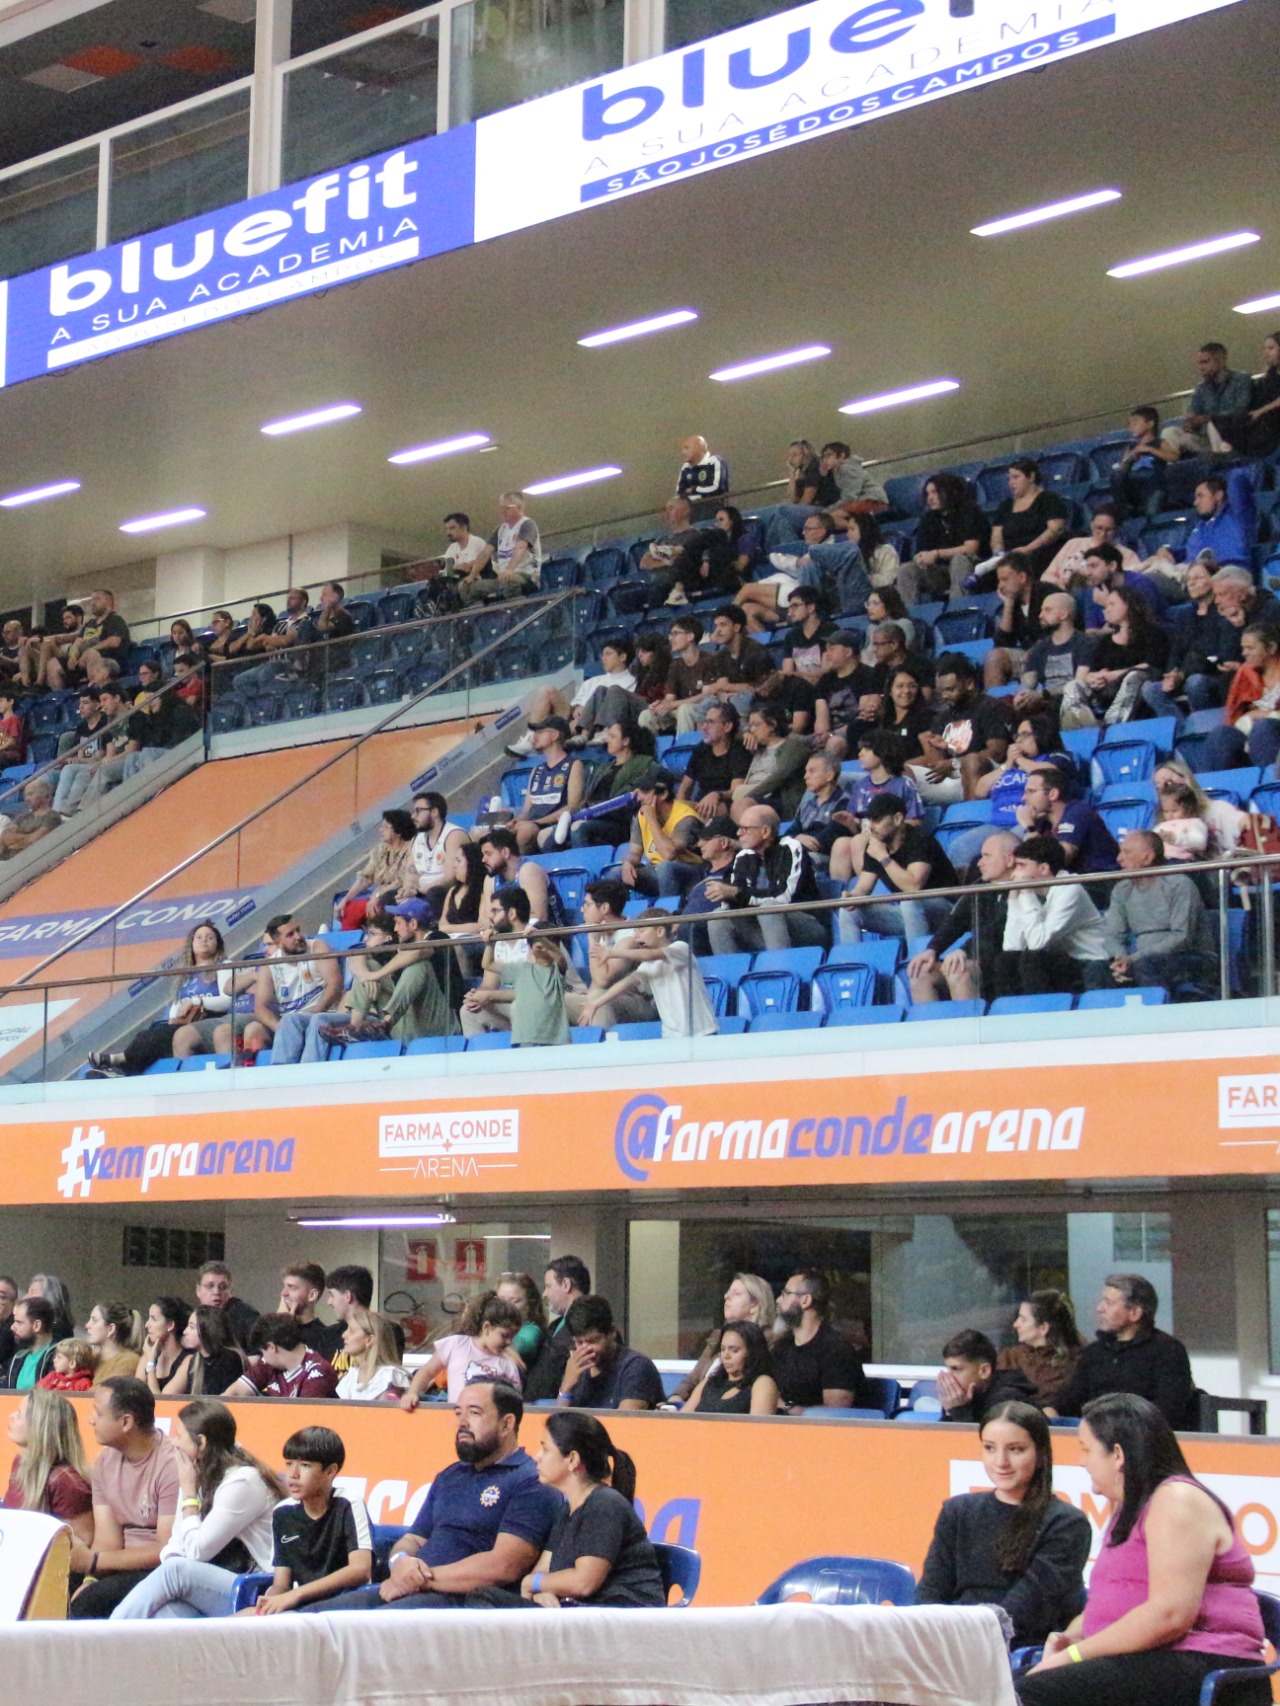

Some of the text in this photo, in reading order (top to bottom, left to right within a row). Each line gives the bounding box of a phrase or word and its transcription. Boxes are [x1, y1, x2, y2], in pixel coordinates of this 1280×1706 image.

[582, 0, 975, 141] blue
[607, 30, 1081, 193] SÃO JOSÉ DOS CAMPOS
[583, 156, 609, 176] A
[641, 112, 745, 156] SUA
[49, 151, 418, 316] bluefit
[51, 217, 418, 345] A SUA ACADEMIA
[57, 1125, 296, 1198] #vempraarena
[384, 1118, 512, 1142] FARMA CONDE
[413, 1156, 479, 1179] ARENA
[615, 1093, 1086, 1183] @farmacondearena
